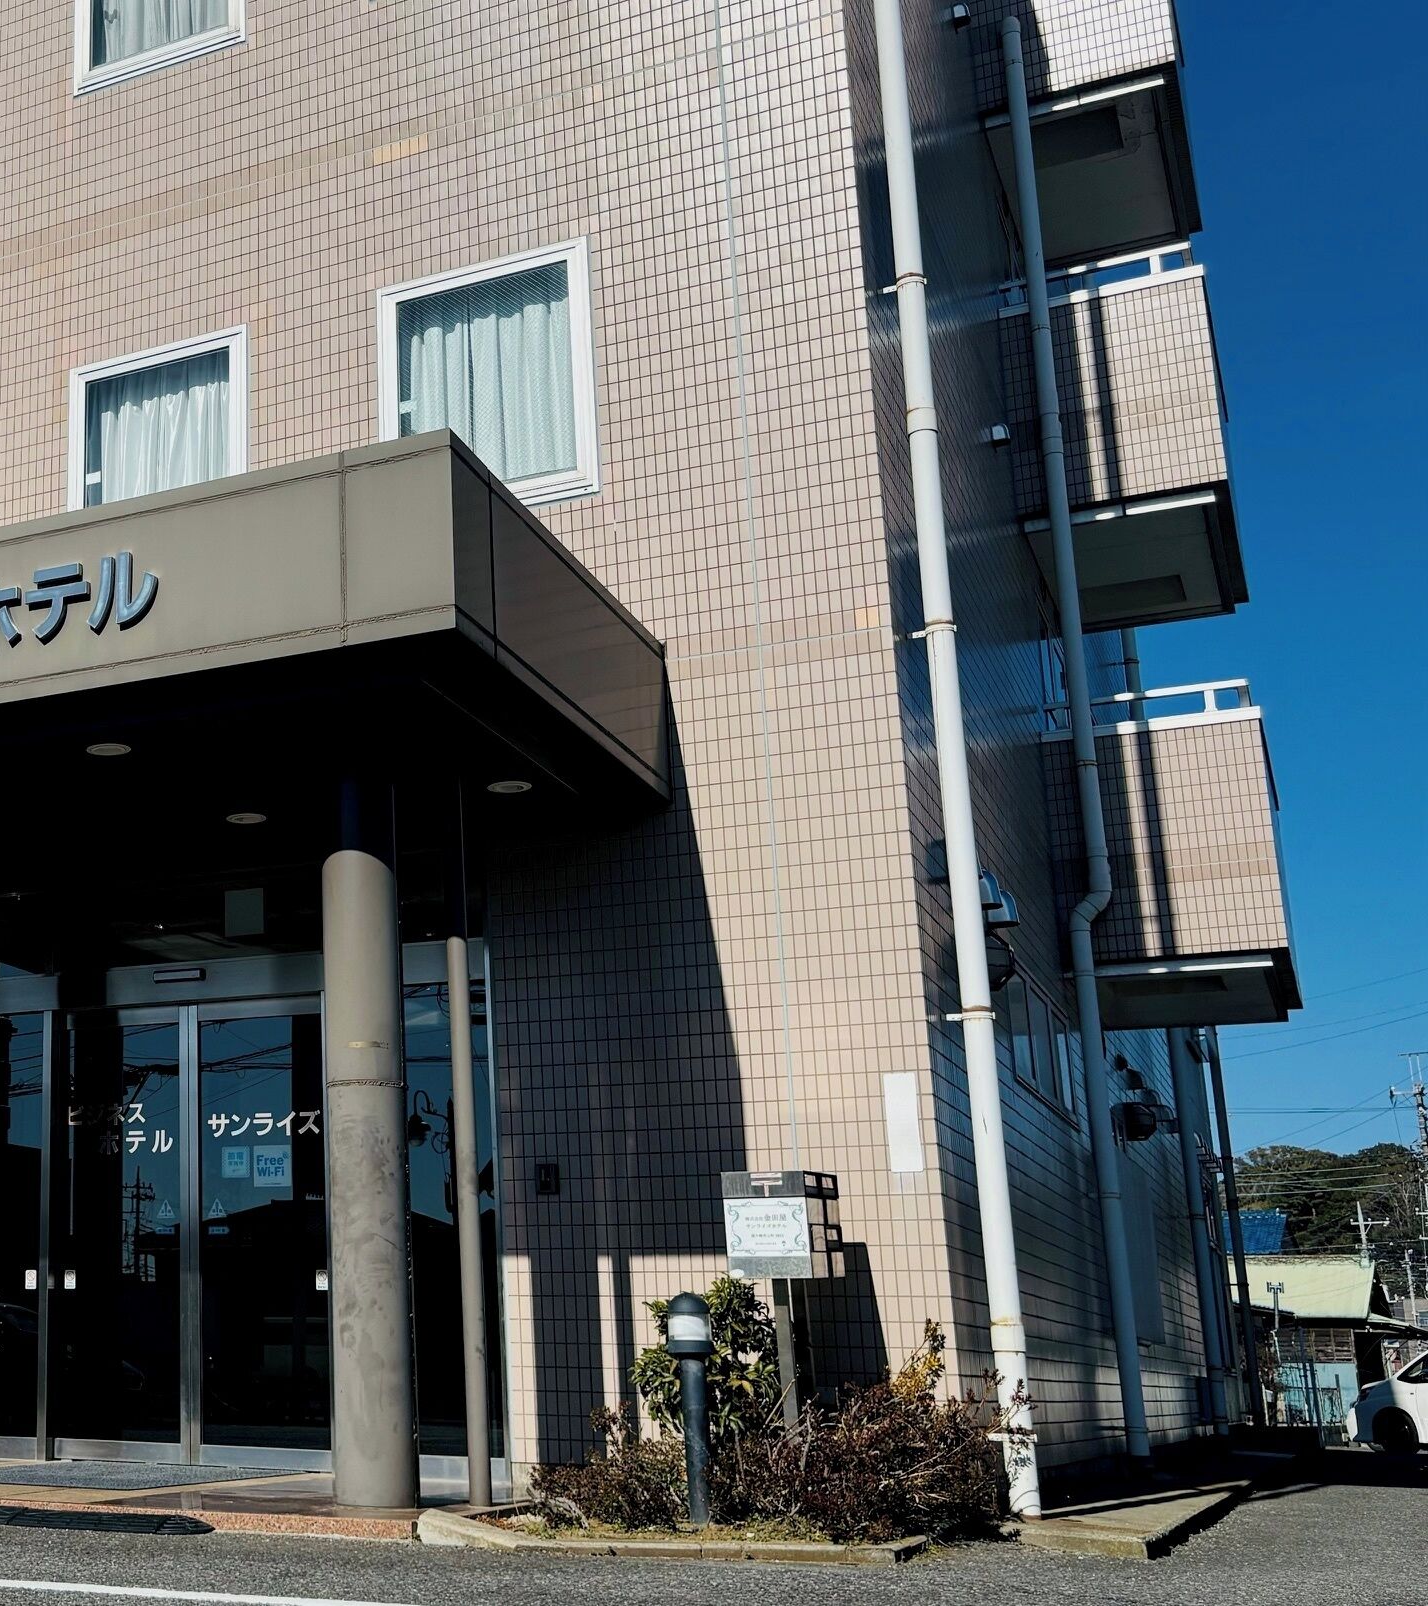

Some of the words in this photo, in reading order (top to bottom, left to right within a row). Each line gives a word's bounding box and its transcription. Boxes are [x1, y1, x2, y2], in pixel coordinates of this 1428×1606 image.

[68, 1103, 147, 1126] ビネス
[207, 1109, 321, 1138] サンライズ
[100, 1129, 174, 1155] ホテル
[256, 1154, 284, 1166] Free
[257, 1166, 285, 1177] Wi-Fi
